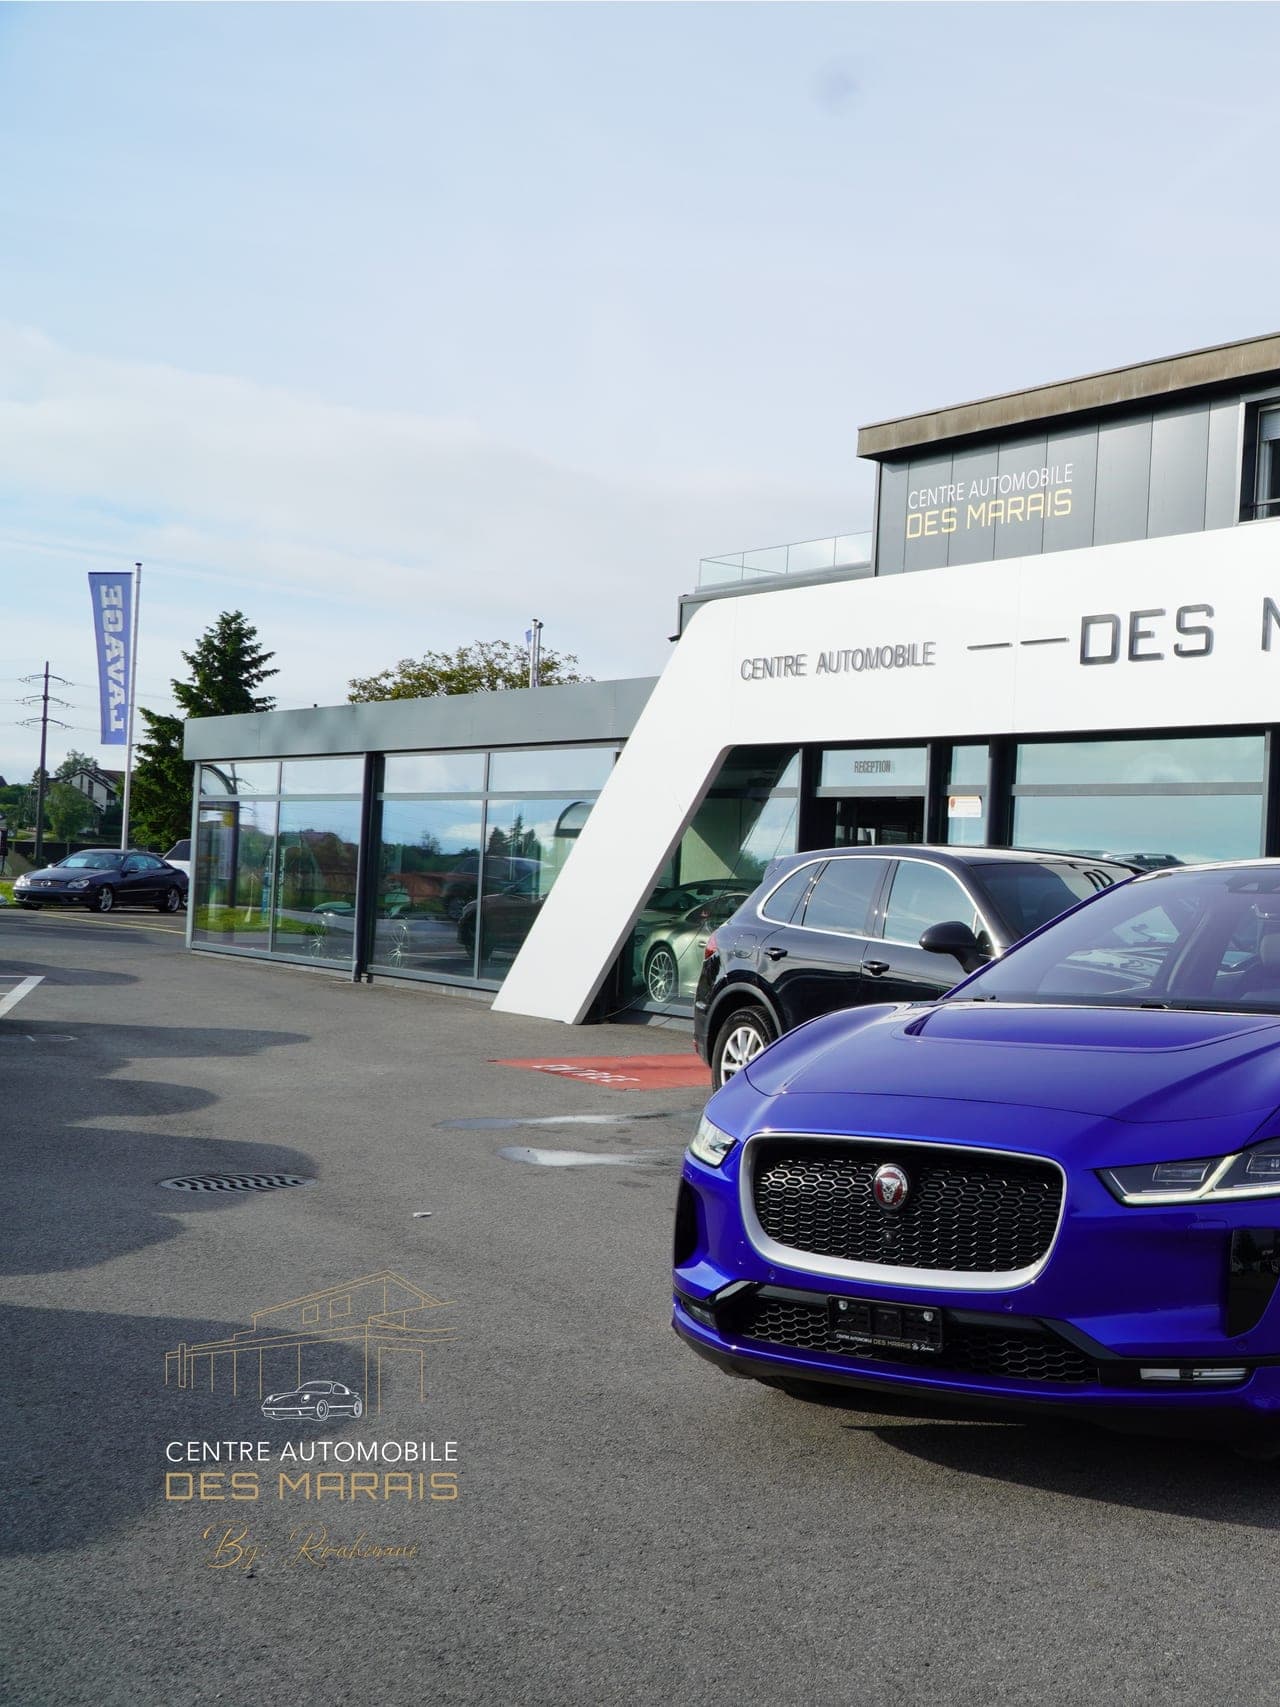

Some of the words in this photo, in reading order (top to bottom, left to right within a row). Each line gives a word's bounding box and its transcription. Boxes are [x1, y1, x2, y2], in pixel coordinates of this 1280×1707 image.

[907, 482, 965, 510] CENTRE
[968, 463, 1073, 499] AUTOMOBILE
[906, 507, 957, 539] DES
[967, 488, 1072, 530] MARAIS
[740, 653, 808, 681] CENTRE
[816, 641, 936, 674] AUTOMOBILE
[1079, 603, 1215, 666] DES
